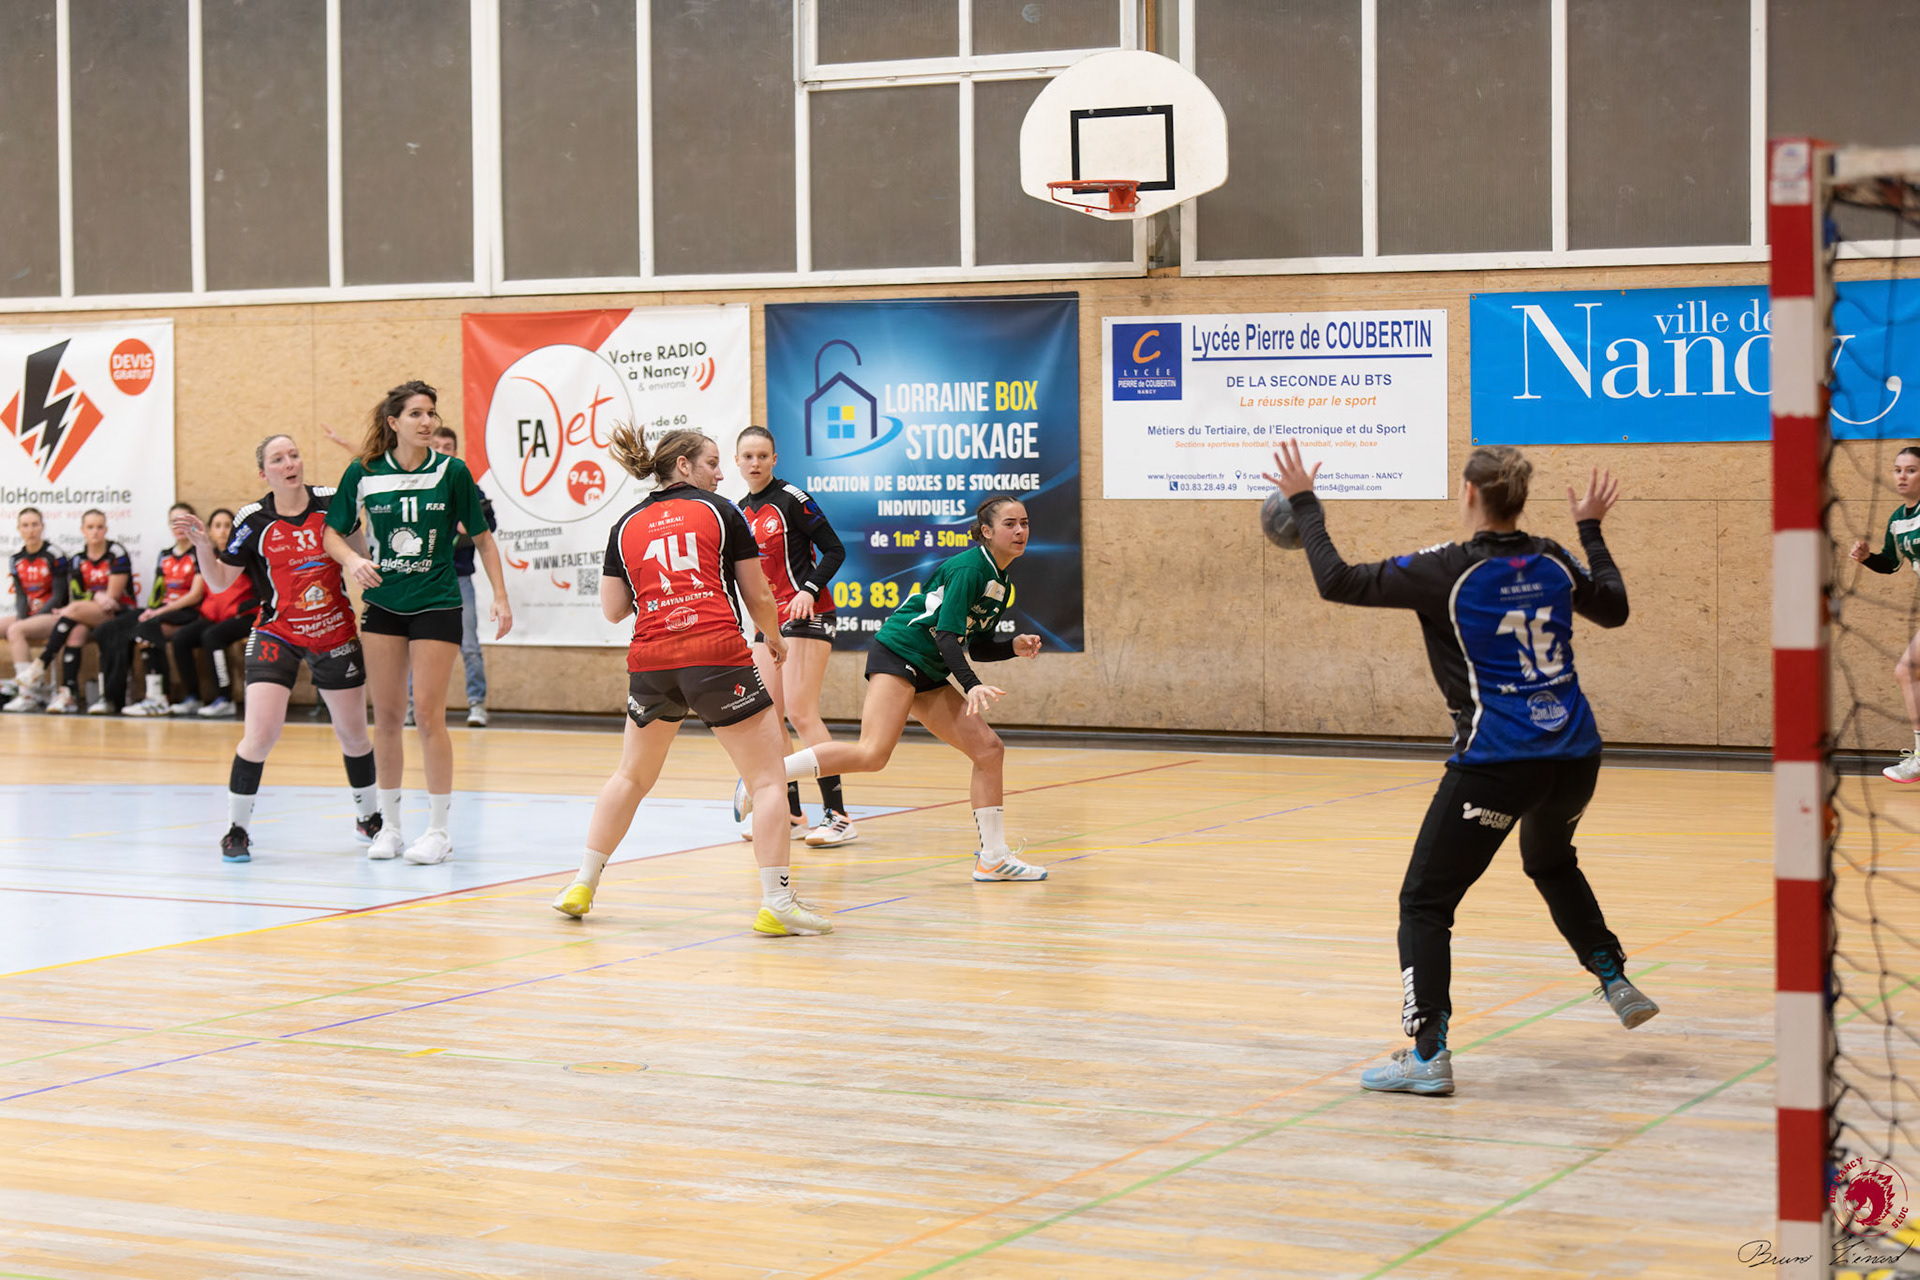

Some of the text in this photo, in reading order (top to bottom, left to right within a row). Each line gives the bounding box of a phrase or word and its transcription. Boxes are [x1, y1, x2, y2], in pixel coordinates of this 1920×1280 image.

[1653, 300, 1729, 335] ville
[1192, 319, 1432, 358] Lycée Pierre de COUBERTIN
[112, 353, 153, 370] DEVIS
[609, 341, 707, 365] Votre RADIO
[628, 365, 690, 382] à Nancy
[1123, 368, 1171, 376] LYCÉE
[1226, 373, 1392, 388] DE LA SECONDE AU BTS
[637, 381, 687, 392] & environs
[1118, 379, 1177, 388] PIERRE de COUBERTIN
[885, 380, 1038, 414] LORRAINE BOX
[1240, 395, 1377, 409] La réussite par le sport
[673, 414, 687, 425] 60
[1147, 423, 1407, 437] Métiers du Tertiaire, de l'Electronique et du Sport
[905, 422, 1040, 460] STOCKAGE
[1175, 440, 1205, 448] Sections
[1207, 440, 1240, 449] sportives
[569, 470, 602, 486] 94.2
[806, 473, 1041, 493] LOCATION DE BOXES DE STOCKAGE
[1147, 472, 1225, 481] www.lyceecoubertin.fr
[1313, 472, 1334, 480] obert
[1335, 472, 1370, 480] Schuman
[1376, 472, 1403, 480] NANCY
[1180, 483, 1238, 491] 03.83.28.49.49
[588, 493, 600, 502] FM
[399, 496, 419, 523] 11
[877, 498, 967, 516] INDIVIDUELS
[292, 529, 317, 552] 33
[498, 526, 563, 540] Programmes
[870, 530, 889, 547] de
[924, 530, 934, 547] à
[514, 540, 549, 551] & Infos
[532, 551, 605, 570] WWW.FAJET.NET
[643, 532, 704, 595] 14
[660, 590, 714, 608] RAYAN DEM 54
[833, 581, 862, 608] 03
[870, 581, 899, 608] 83
[836, 616, 858, 632] 256
[861, 618, 882, 632] rue
[257, 640, 280, 662] 33
[1481, 808, 1513, 824] INTER
